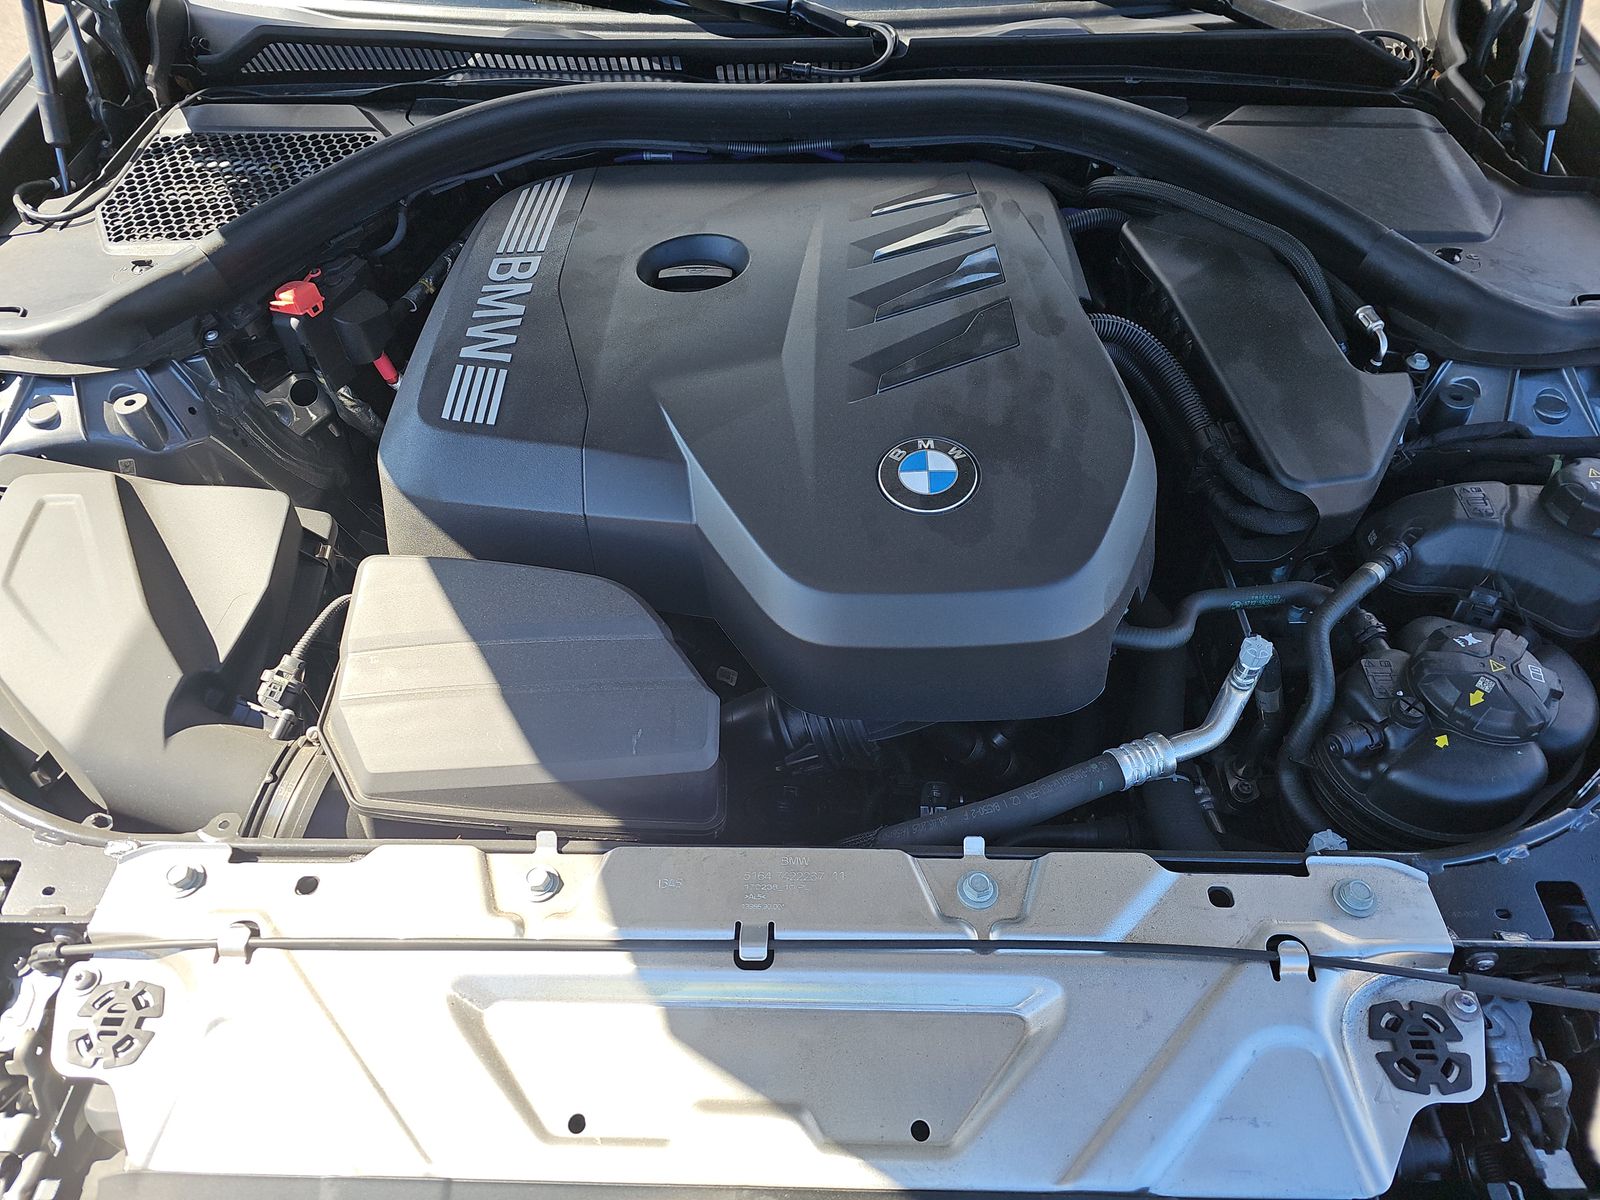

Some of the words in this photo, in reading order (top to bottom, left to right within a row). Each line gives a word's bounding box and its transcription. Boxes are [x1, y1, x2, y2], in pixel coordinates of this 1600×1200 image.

[459, 255, 542, 363] BMW
[888, 439, 967, 462] BMW
[781, 856, 809, 866] BMW
